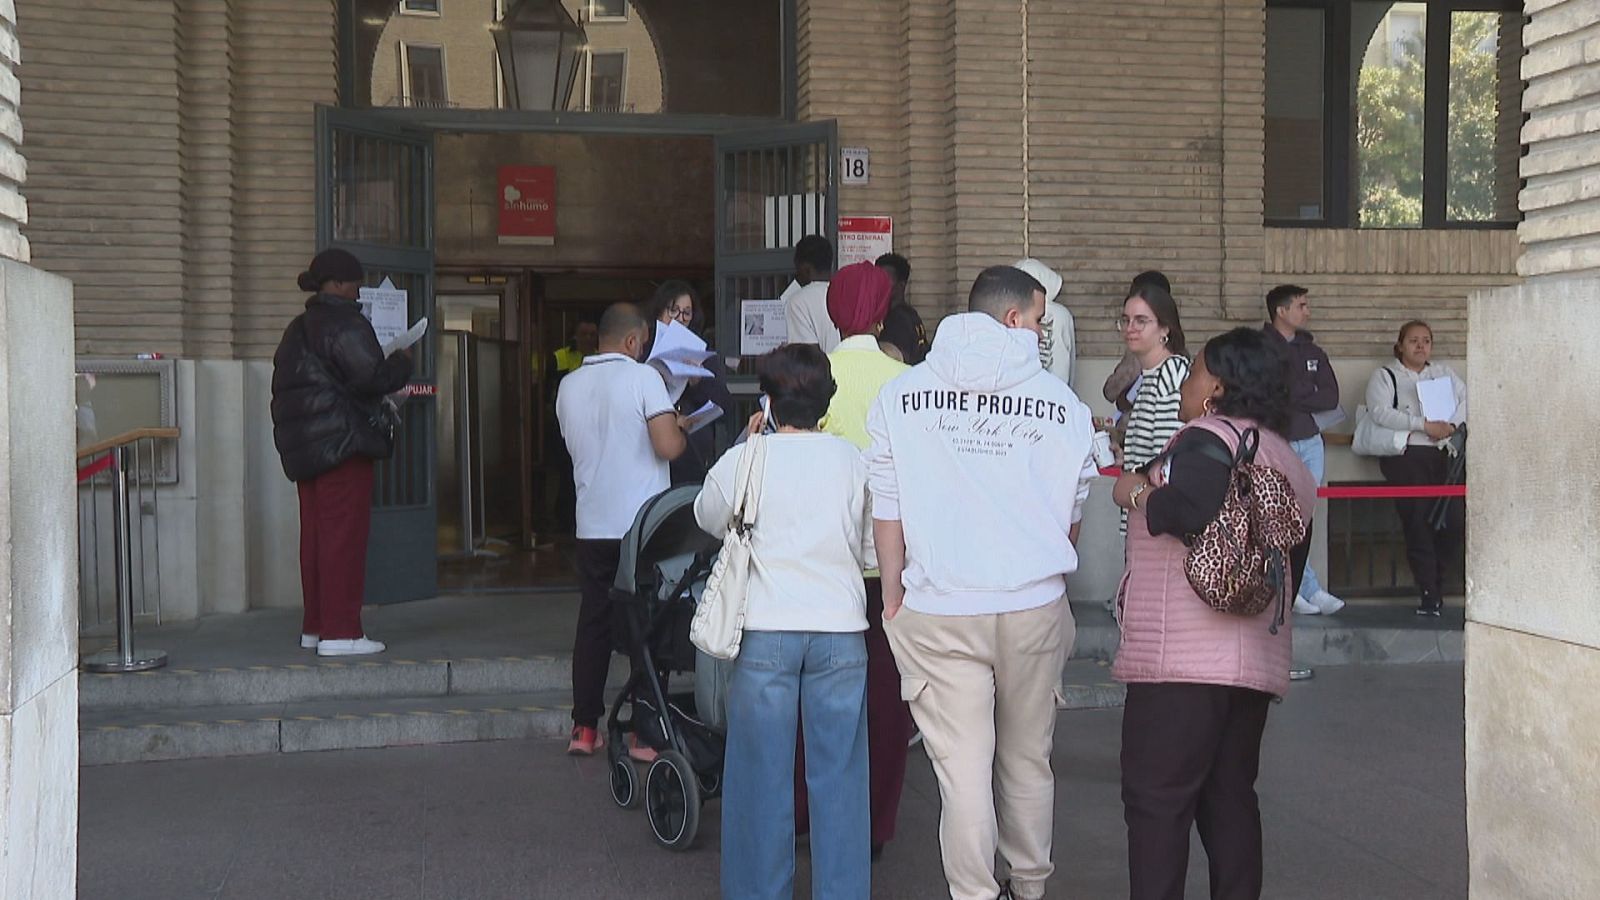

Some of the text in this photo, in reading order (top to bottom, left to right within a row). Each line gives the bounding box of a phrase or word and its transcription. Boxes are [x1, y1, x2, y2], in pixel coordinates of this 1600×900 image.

[845, 157, 865, 178] 18
[901, 389, 1067, 425] FUTURE PROJECTS
[925, 413, 1046, 446] New York City
